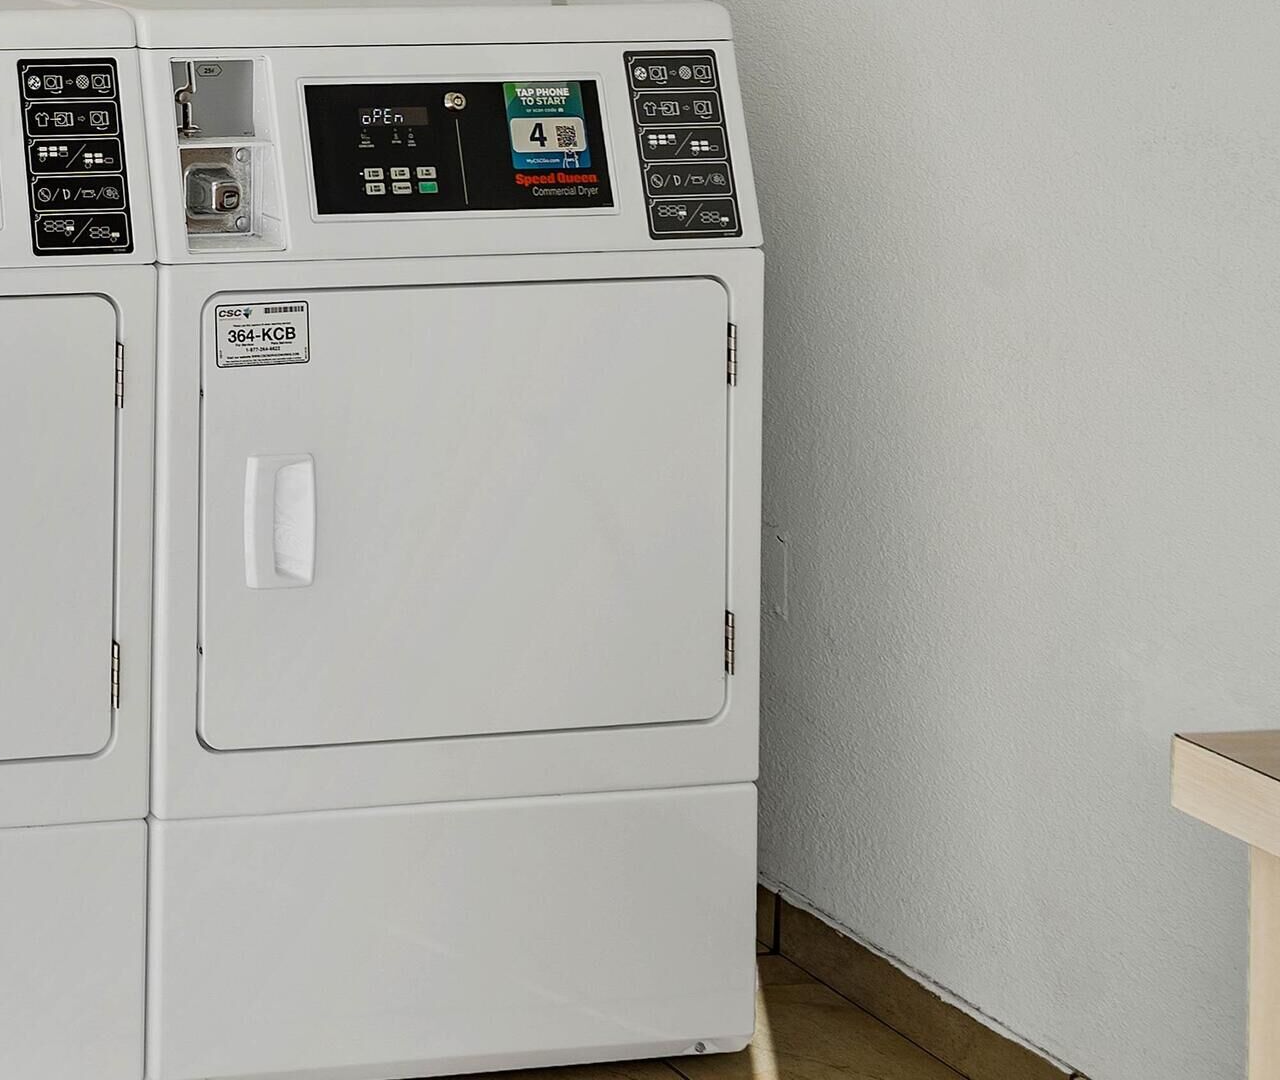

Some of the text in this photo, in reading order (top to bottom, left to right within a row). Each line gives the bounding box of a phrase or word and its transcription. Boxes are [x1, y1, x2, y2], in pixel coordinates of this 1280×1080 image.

[515, 88, 570, 97] TAP PHONE
[520, 97, 567, 105] TO START
[530, 123, 547, 147] 4
[515, 173, 597, 186] Speed Queen
[532, 186, 598, 197] Commercial Dryer
[219, 309, 242, 318] CSC
[228, 326, 296, 343] 364-KCB
